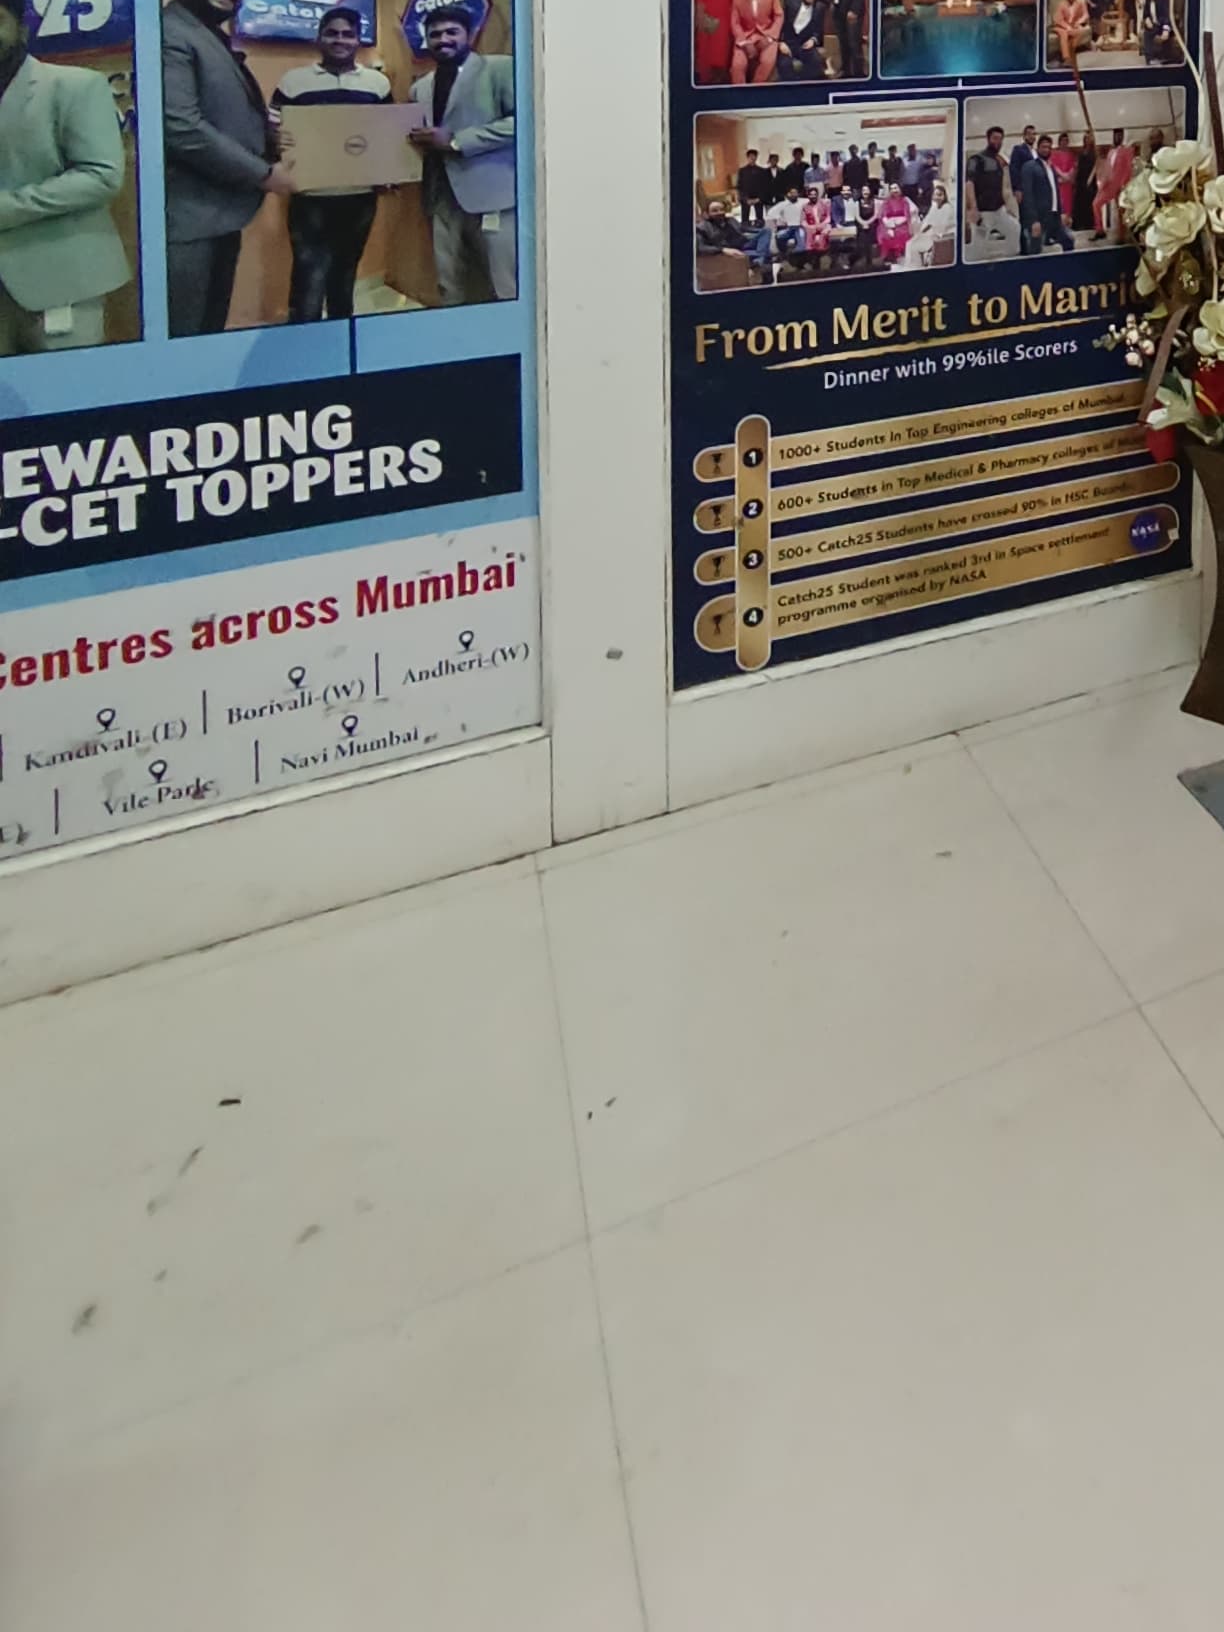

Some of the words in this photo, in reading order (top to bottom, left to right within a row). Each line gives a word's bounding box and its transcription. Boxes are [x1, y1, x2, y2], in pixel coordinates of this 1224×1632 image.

[694, 318, 818, 363] From
[832, 296, 947, 346] Merit
[968, 292, 1009, 325] to
[1020, 272, 1137, 319] Marri
[823, 367, 890, 390] Dinner
[895, 358, 937, 379] with
[942, 347, 1009, 373] 99%ile
[1015, 338, 1078, 361] Scorers
[0, 405, 353, 500] EWARDING
[748, 450, 757, 465] 1
[779, 444, 821, 460] 1000+
[827, 435, 886, 453] Students
[906, 425, 928, 440] Top
[933, 414, 1007, 435] Engineering
[1011, 406, 1058, 421] colleges
[1063, 401, 1074, 412] of
[166, 439, 442, 523] TOPPERS
[748, 501, 758, 516] 2
[778, 496, 812, 511] 600+
[818, 485, 878, 503] Students
[882, 481, 893, 493] in
[897, 477, 921, 491] Top
[925, 464, 974, 483] Medical
[977, 462, 987, 473] &
[991, 451, 1049, 471] Pharmacy
[1053, 444, 1099, 460] colleges
[748, 552, 758, 567] 3
[778, 547, 812, 561] 500+
[818, 533, 873, 553] Catch25
[876, 523, 934, 542] Students
[937, 517, 967, 530] have
[971, 503, 1018, 522] crossed
[1131, 520, 1160, 537] NASA
[191, 596, 339, 651] across
[356, 552, 516, 618] Mumbai
[748, 609, 758, 624] 4
[777, 587, 833, 608] Catch25
[838, 575, 891, 594] Student
[894, 570, 919, 583] was
[923, 556, 967, 576] ranked
[970, 550, 991, 566] 3rd
[995, 548, 1006, 560] in
[1009, 542, 1045, 559] Space
[777, 599, 857, 625] programme
[861, 583, 926, 606] organised
[929, 577, 946, 593] by
[950, 570, 987, 587] NASA
[281, 747, 329, 773] Navi
[335, 726, 420, 762] Mumbai
[103, 793, 150, 816] Vile
